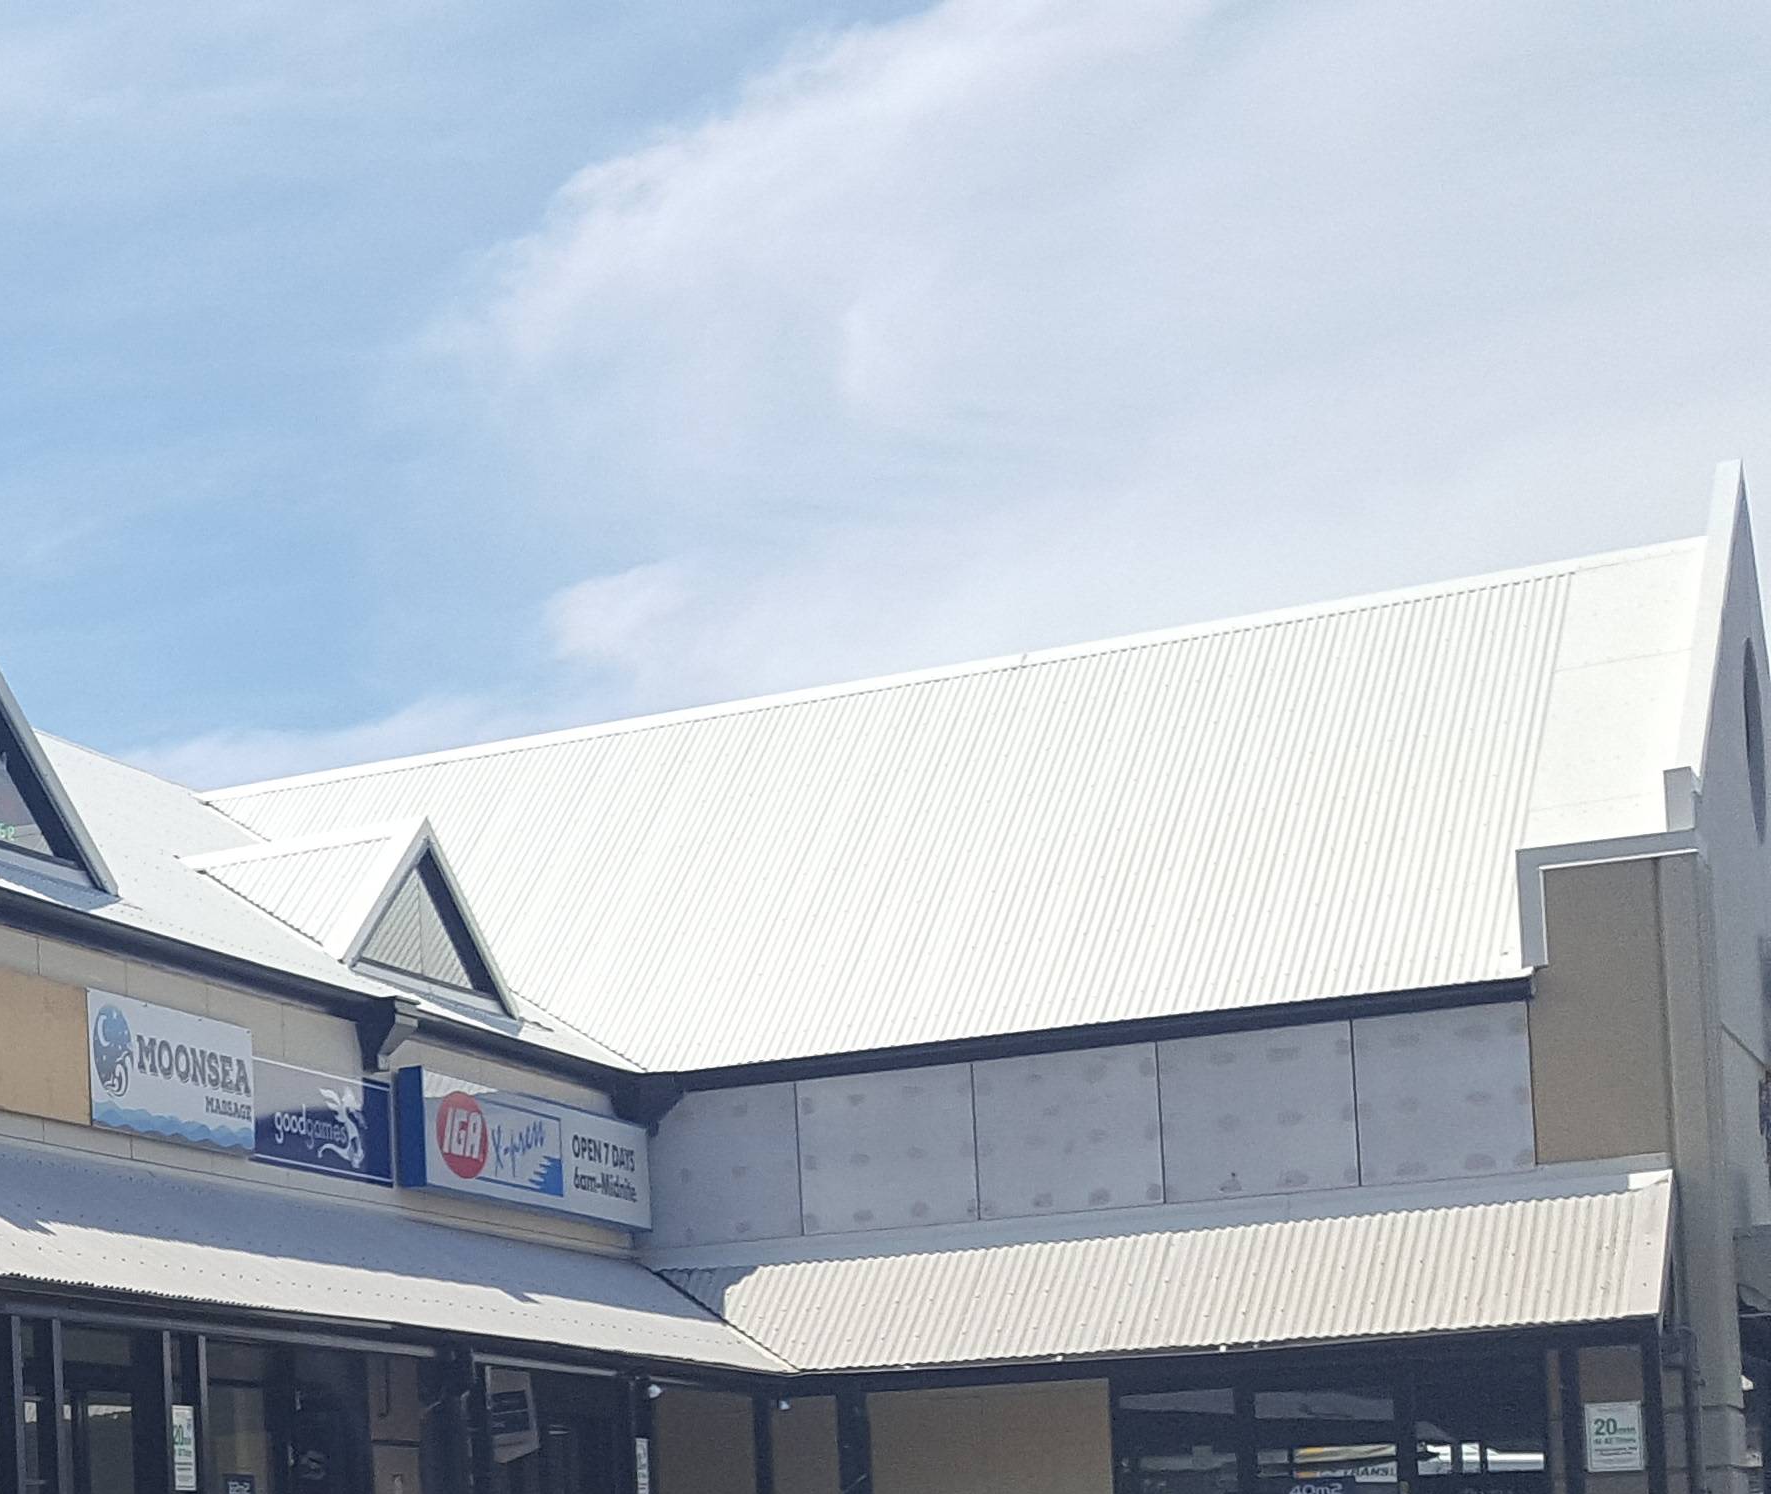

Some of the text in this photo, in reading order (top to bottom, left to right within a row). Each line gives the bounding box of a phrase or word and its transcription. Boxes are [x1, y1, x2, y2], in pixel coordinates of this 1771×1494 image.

[136, 1035, 252, 1098] MOONSEA
[205, 1096, 252, 1121] MASSAGE
[442, 1106, 483, 1161] IGA
[572, 1134, 636, 1172] OPEN 7 DAYS
[1594, 1418, 1617, 1435] 20
